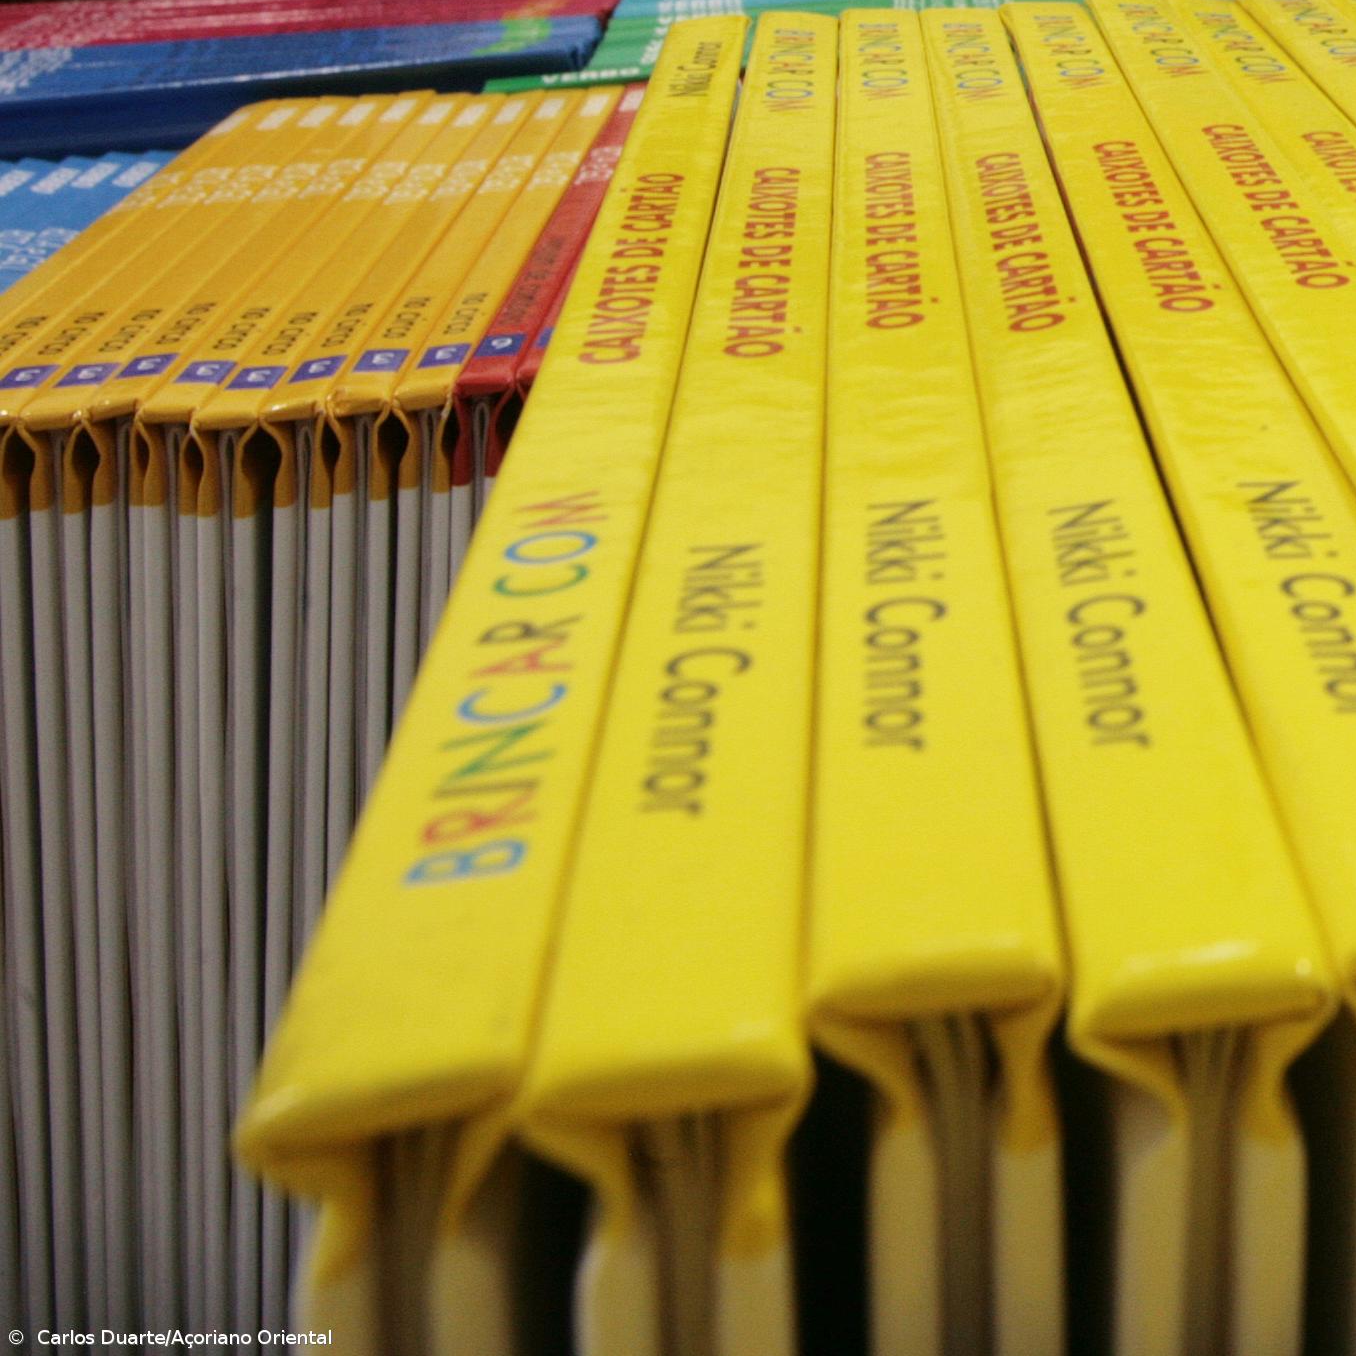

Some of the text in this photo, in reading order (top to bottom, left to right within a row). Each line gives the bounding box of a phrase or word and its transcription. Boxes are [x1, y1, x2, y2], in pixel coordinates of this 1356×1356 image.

[578, 171, 686, 365] CAIXOTES DE CARTÃO
[722, 166, 803, 359] CAIXOTES DE CARTÃO
[863, 151, 940, 330] CAIXOTES DE CARTÃO
[975, 151, 1078, 333] CAIXOTES DE CARTÃO
[1092, 140, 1222, 313] CAIXOTES DE CARTÃO
[1200, 124, 1355, 290] CAIXOTES DE CARTÃO
[490, 489, 610, 599] COM
[403, 612, 586, 889] BRINCAR
